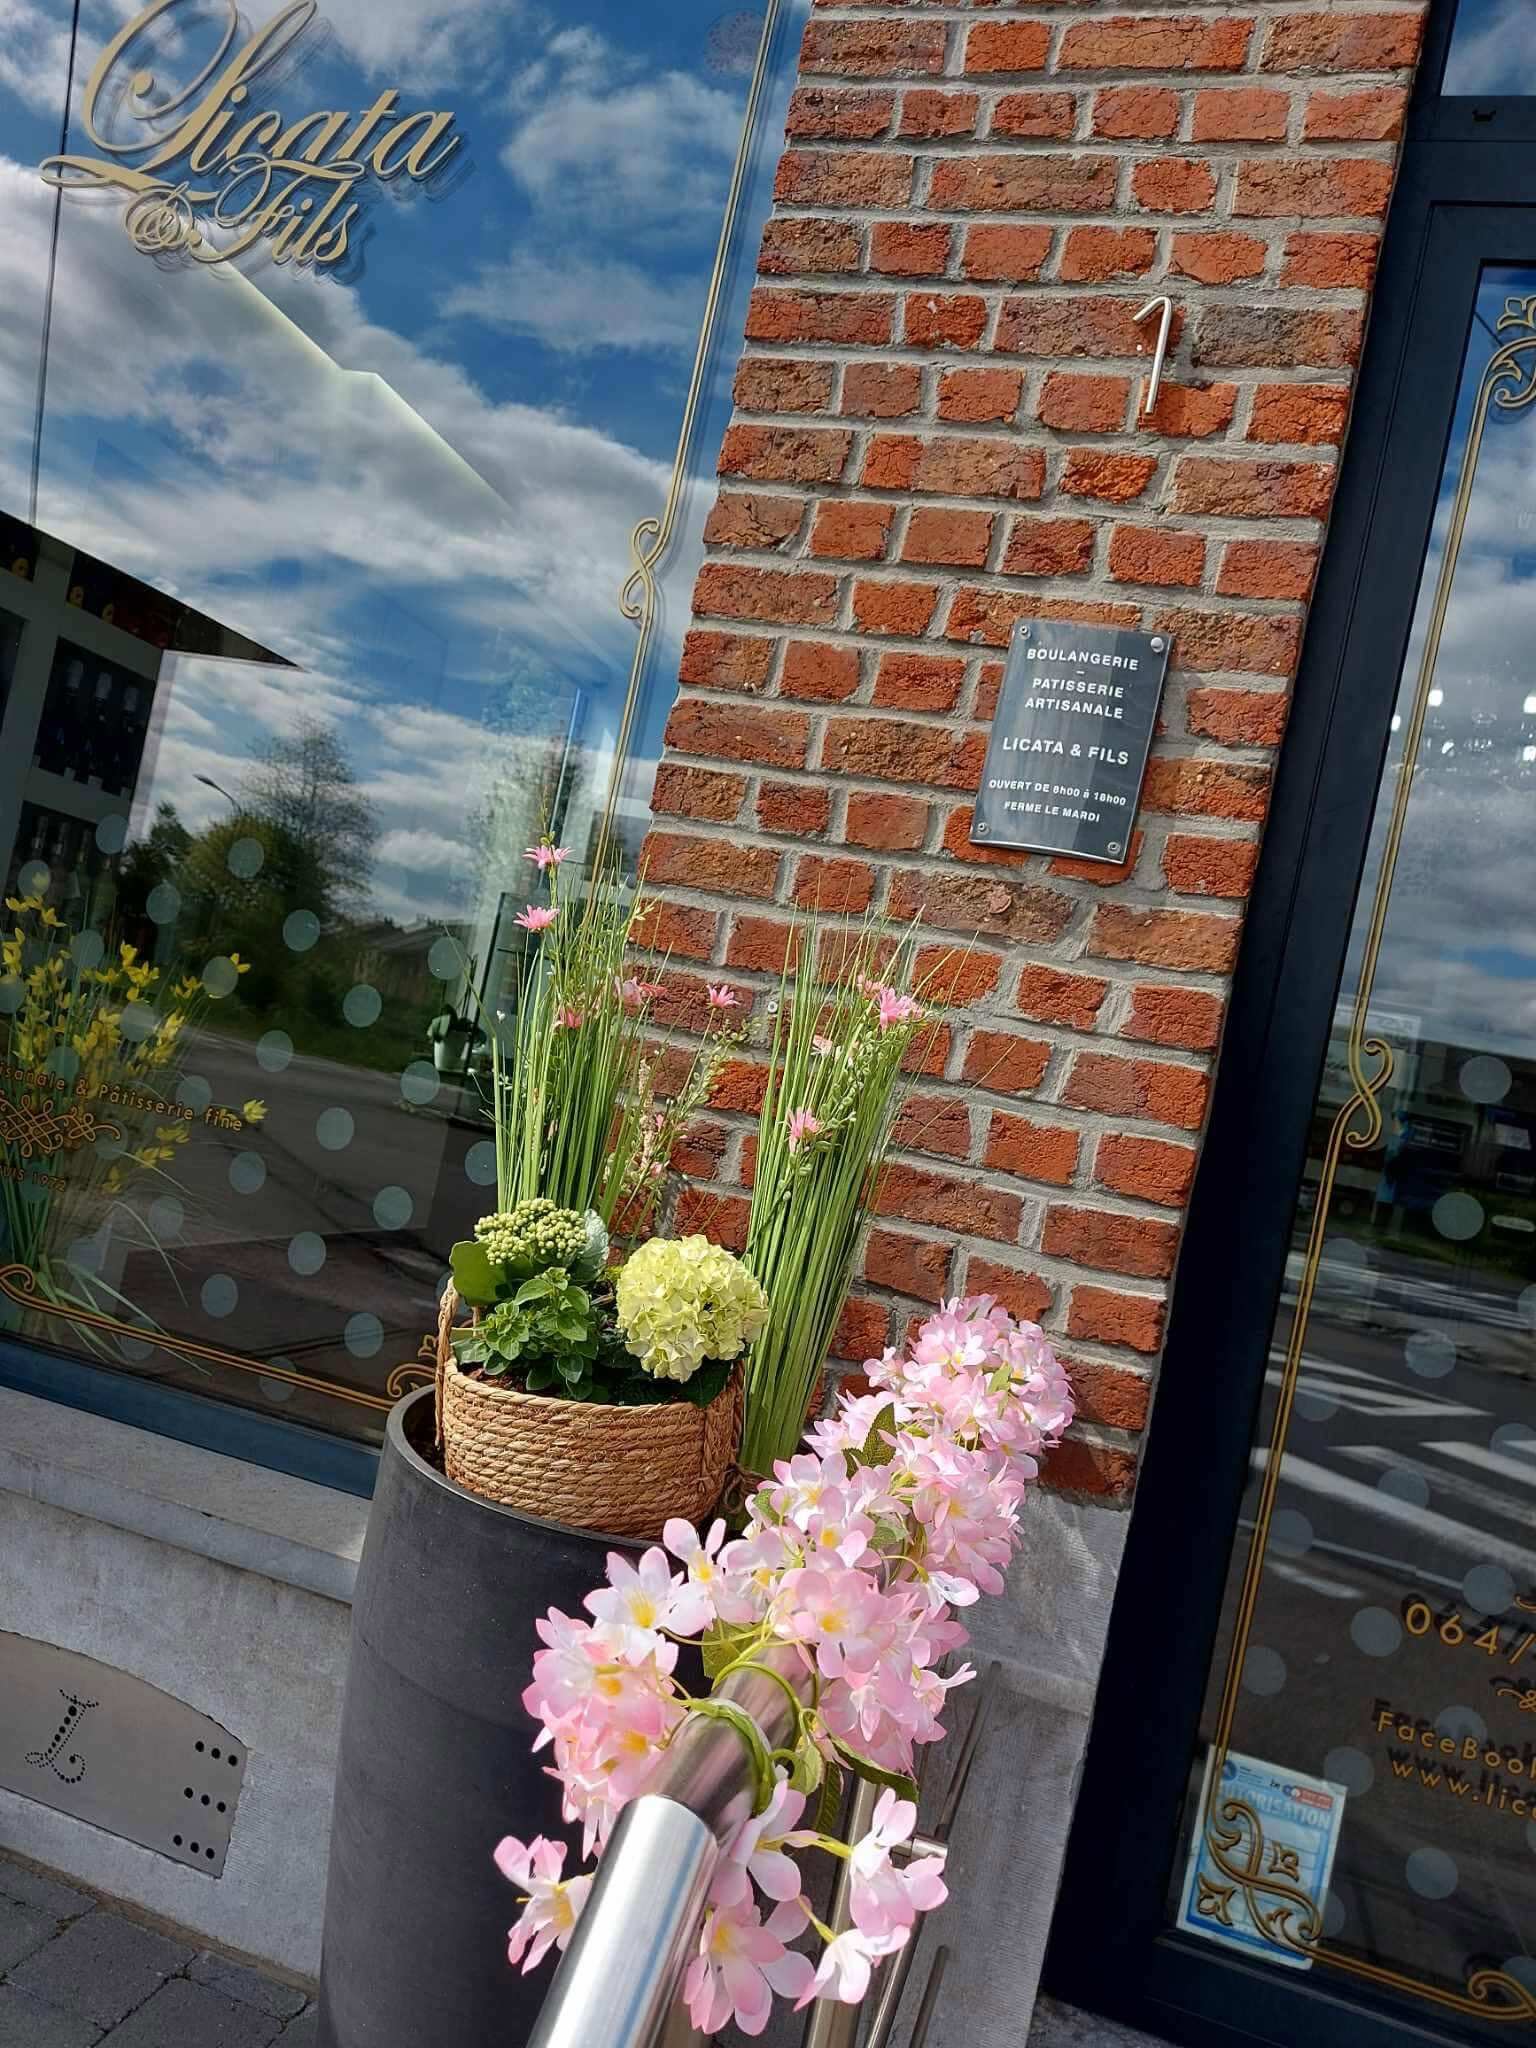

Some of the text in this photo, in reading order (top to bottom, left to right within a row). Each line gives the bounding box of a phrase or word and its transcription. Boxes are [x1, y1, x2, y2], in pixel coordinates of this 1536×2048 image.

[40, 0, 459, 202] Licata
[192, 152, 365, 264] Fils
[1027, 648, 1139, 671] BOULANGERIE
[1032, 678, 1124, 699] PATISSERIE
[1025, 697, 1123, 719] ARTISANALE
[1003, 737, 1129, 765] LICATA & FILS
[989, 779, 1031, 791] OUVERT
[1034, 782, 1049, 793] DE
[1053, 785, 1080, 798] 8h00
[1094, 792, 1126, 806] 18h00
[1004, 801, 1100, 822] FERME LE MARDI
[76, 1079, 88, 1096] &
[100, 1084, 194, 1120] Pâtisserie
[205, 1106, 242, 1132] fine
